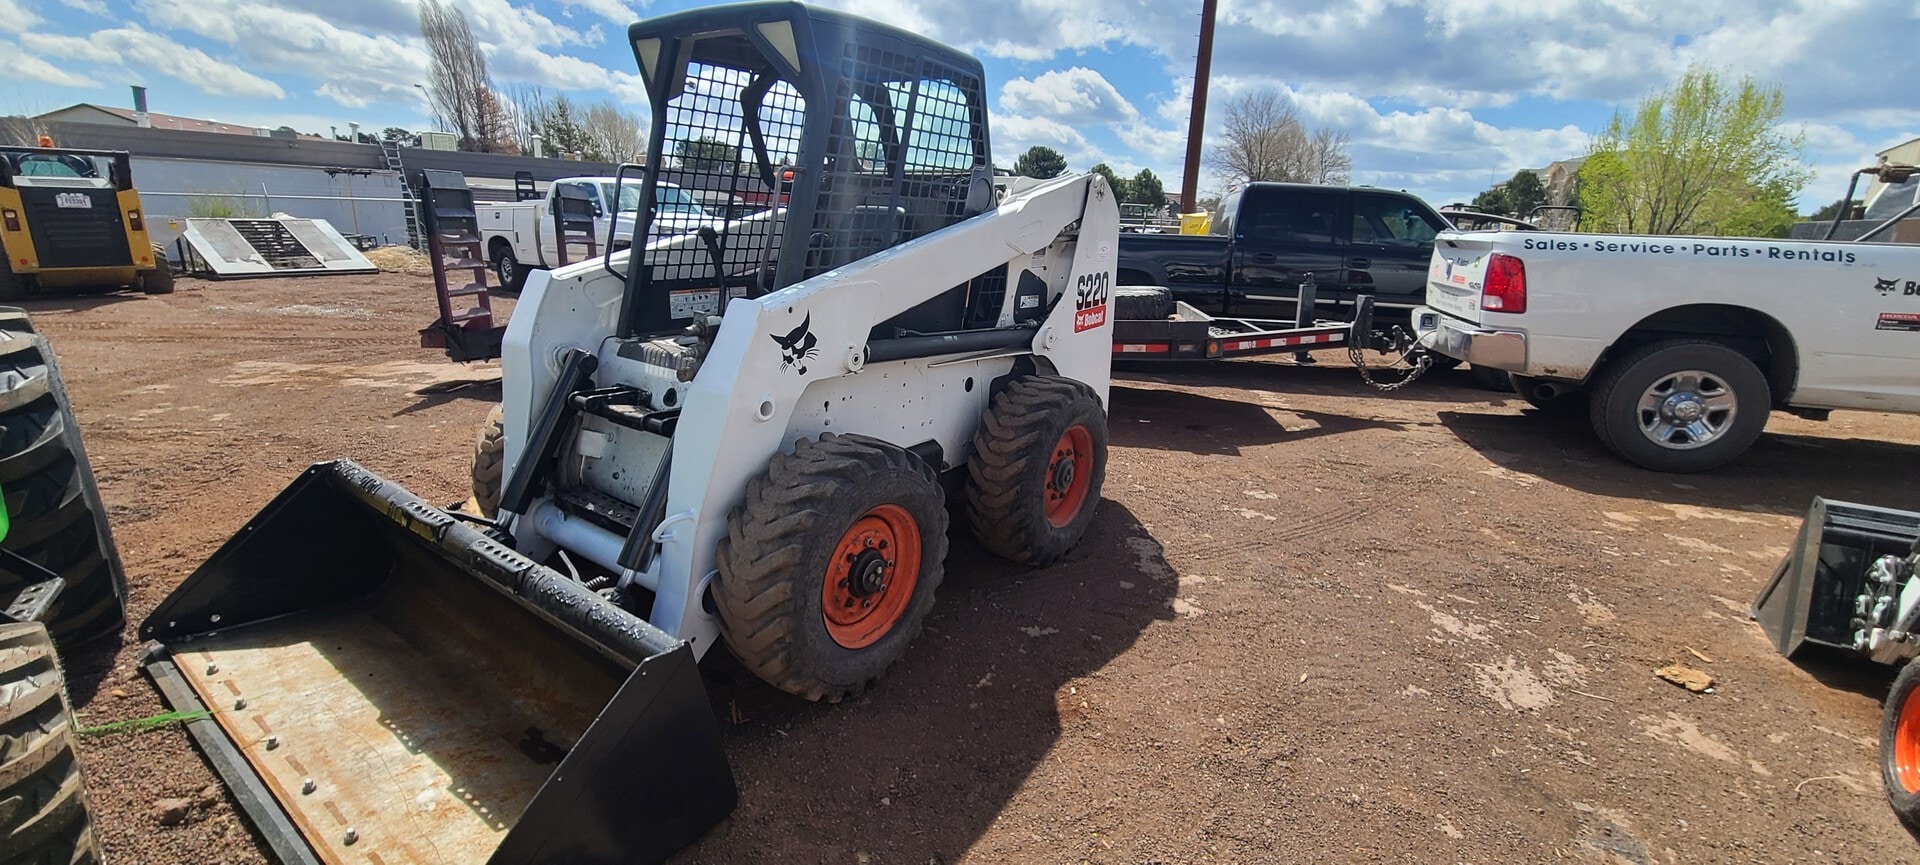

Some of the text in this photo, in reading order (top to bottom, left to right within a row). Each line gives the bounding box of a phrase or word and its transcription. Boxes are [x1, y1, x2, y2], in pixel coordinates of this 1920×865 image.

[1524, 238, 1856, 263] Sales Service Parts Rentals
[1076, 271, 1109, 310] S220
